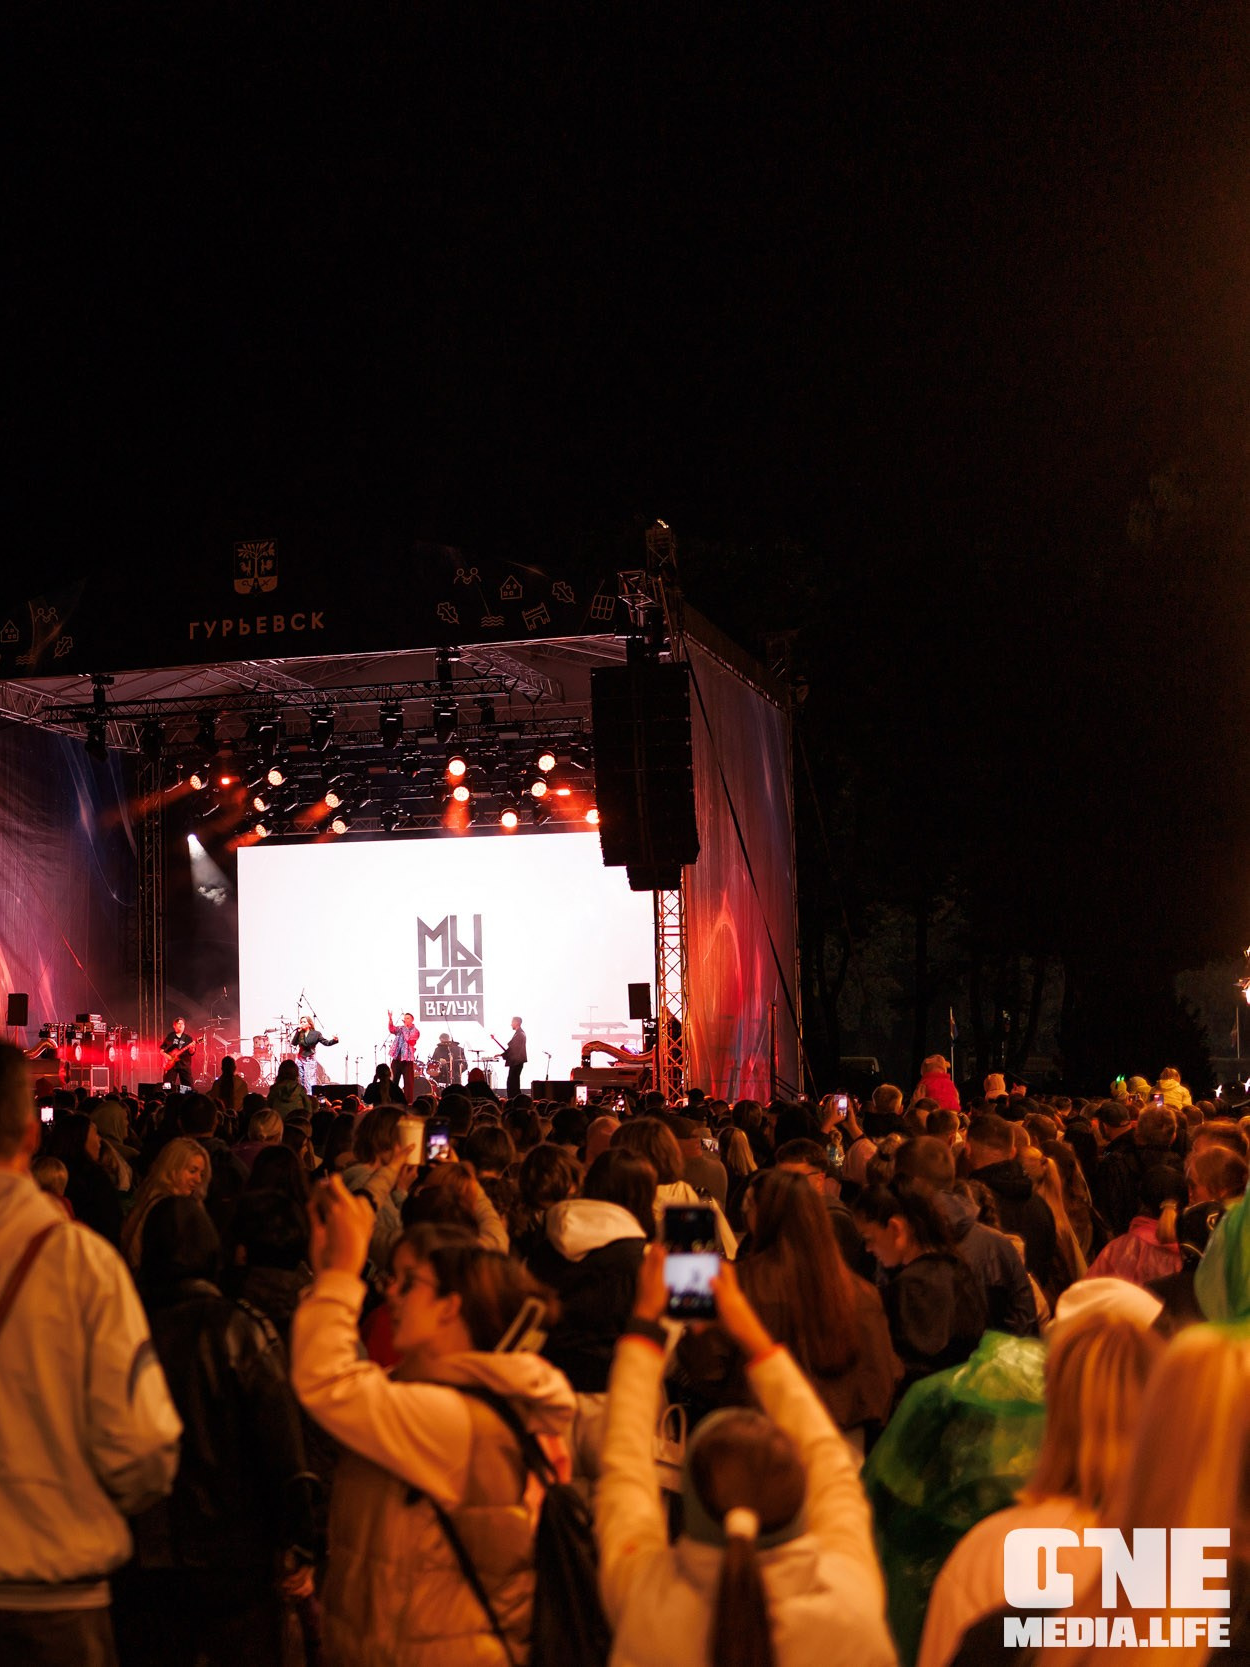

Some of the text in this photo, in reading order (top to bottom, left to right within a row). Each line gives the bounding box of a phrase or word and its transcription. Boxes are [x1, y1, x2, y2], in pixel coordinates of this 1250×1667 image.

[189, 611, 325, 640] ГУРЬЕВСК
[417, 914, 482, 968] МЫ
[418, 969, 483, 994] СЛИ
[425, 1000, 478, 1016] ВСЛУХ
